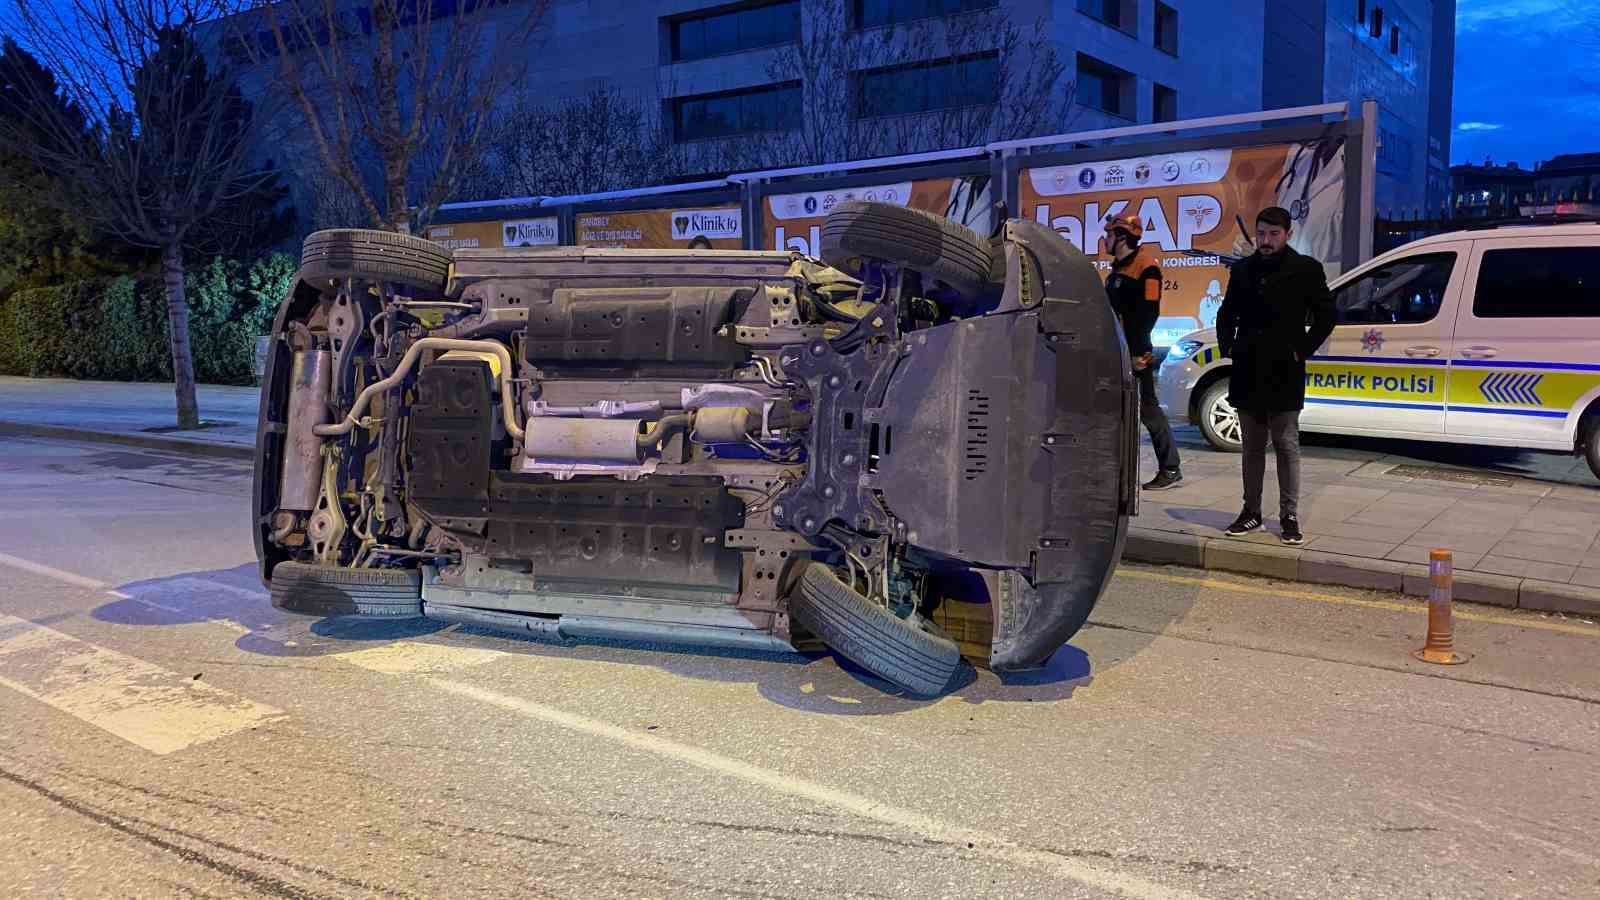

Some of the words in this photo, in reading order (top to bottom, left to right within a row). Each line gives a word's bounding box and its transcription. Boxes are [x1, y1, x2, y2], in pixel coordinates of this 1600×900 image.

[1163, 255, 1220, 267] KONGRESİ
[1163, 280, 1178, 291] 26
[1304, 371, 1366, 390] TRAFİK
[1372, 374, 1434, 393] POLİSİ
